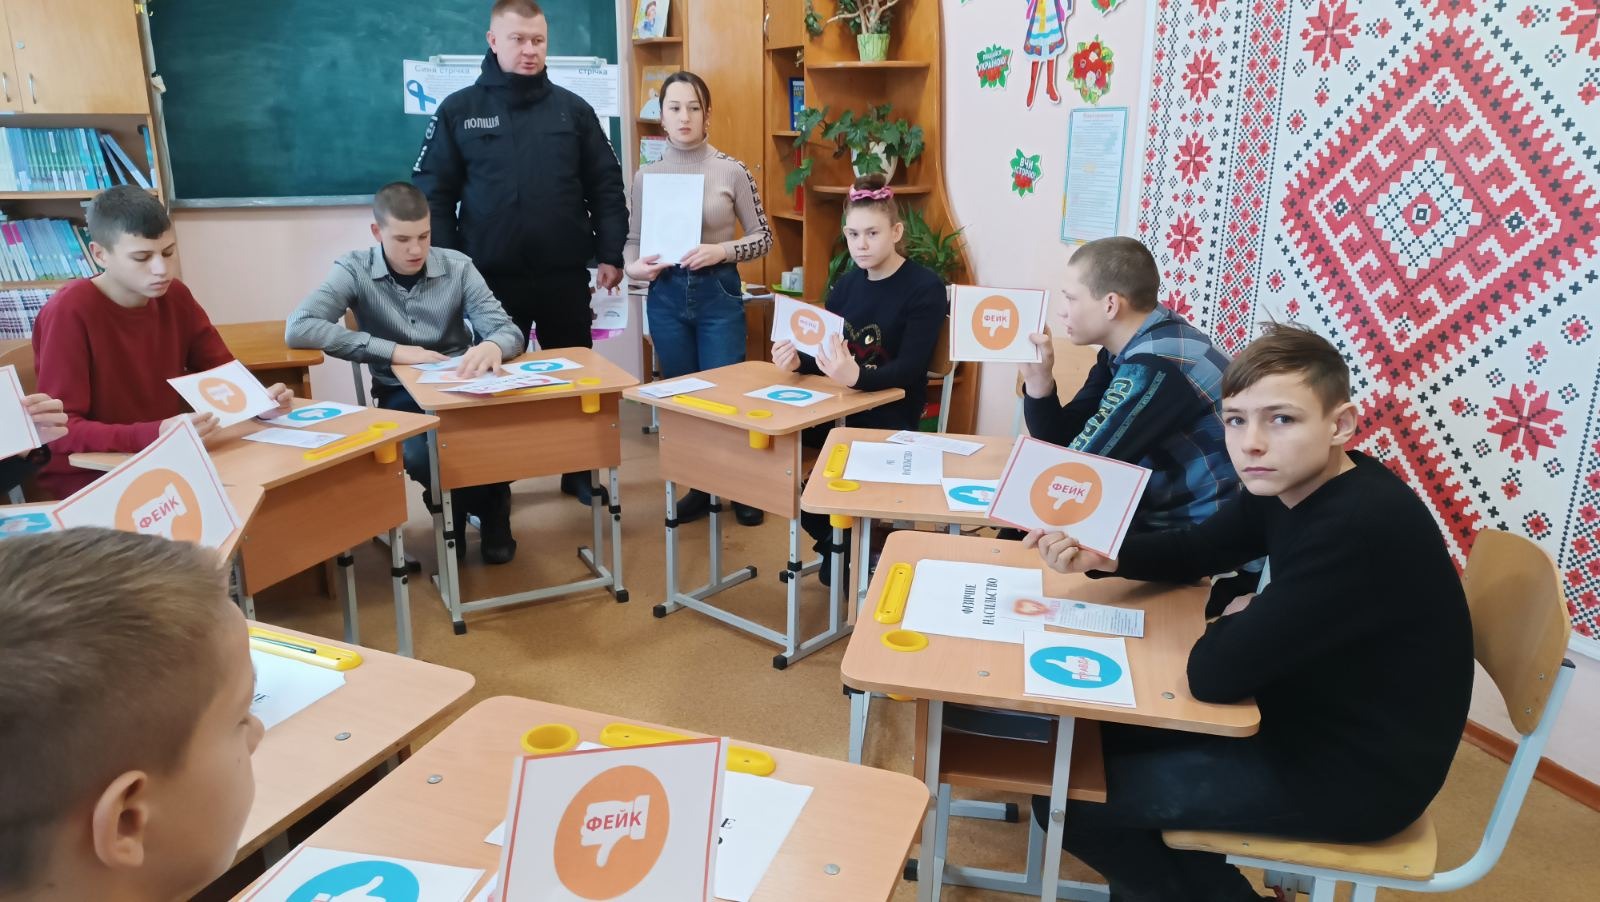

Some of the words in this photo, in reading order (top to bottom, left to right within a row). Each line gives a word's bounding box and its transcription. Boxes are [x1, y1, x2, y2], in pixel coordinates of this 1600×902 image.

[464, 115, 500, 129] ПОЛІЦІЯ
[1019, 157, 1034, 170] ВЧИ
[1052, 482, 1086, 497] ФЕЙК
[140, 495, 180, 528] ФЕЙК
[982, 577, 999, 625] НАСИЛЬСТВО
[586, 809, 643, 832] ФЕЙК
